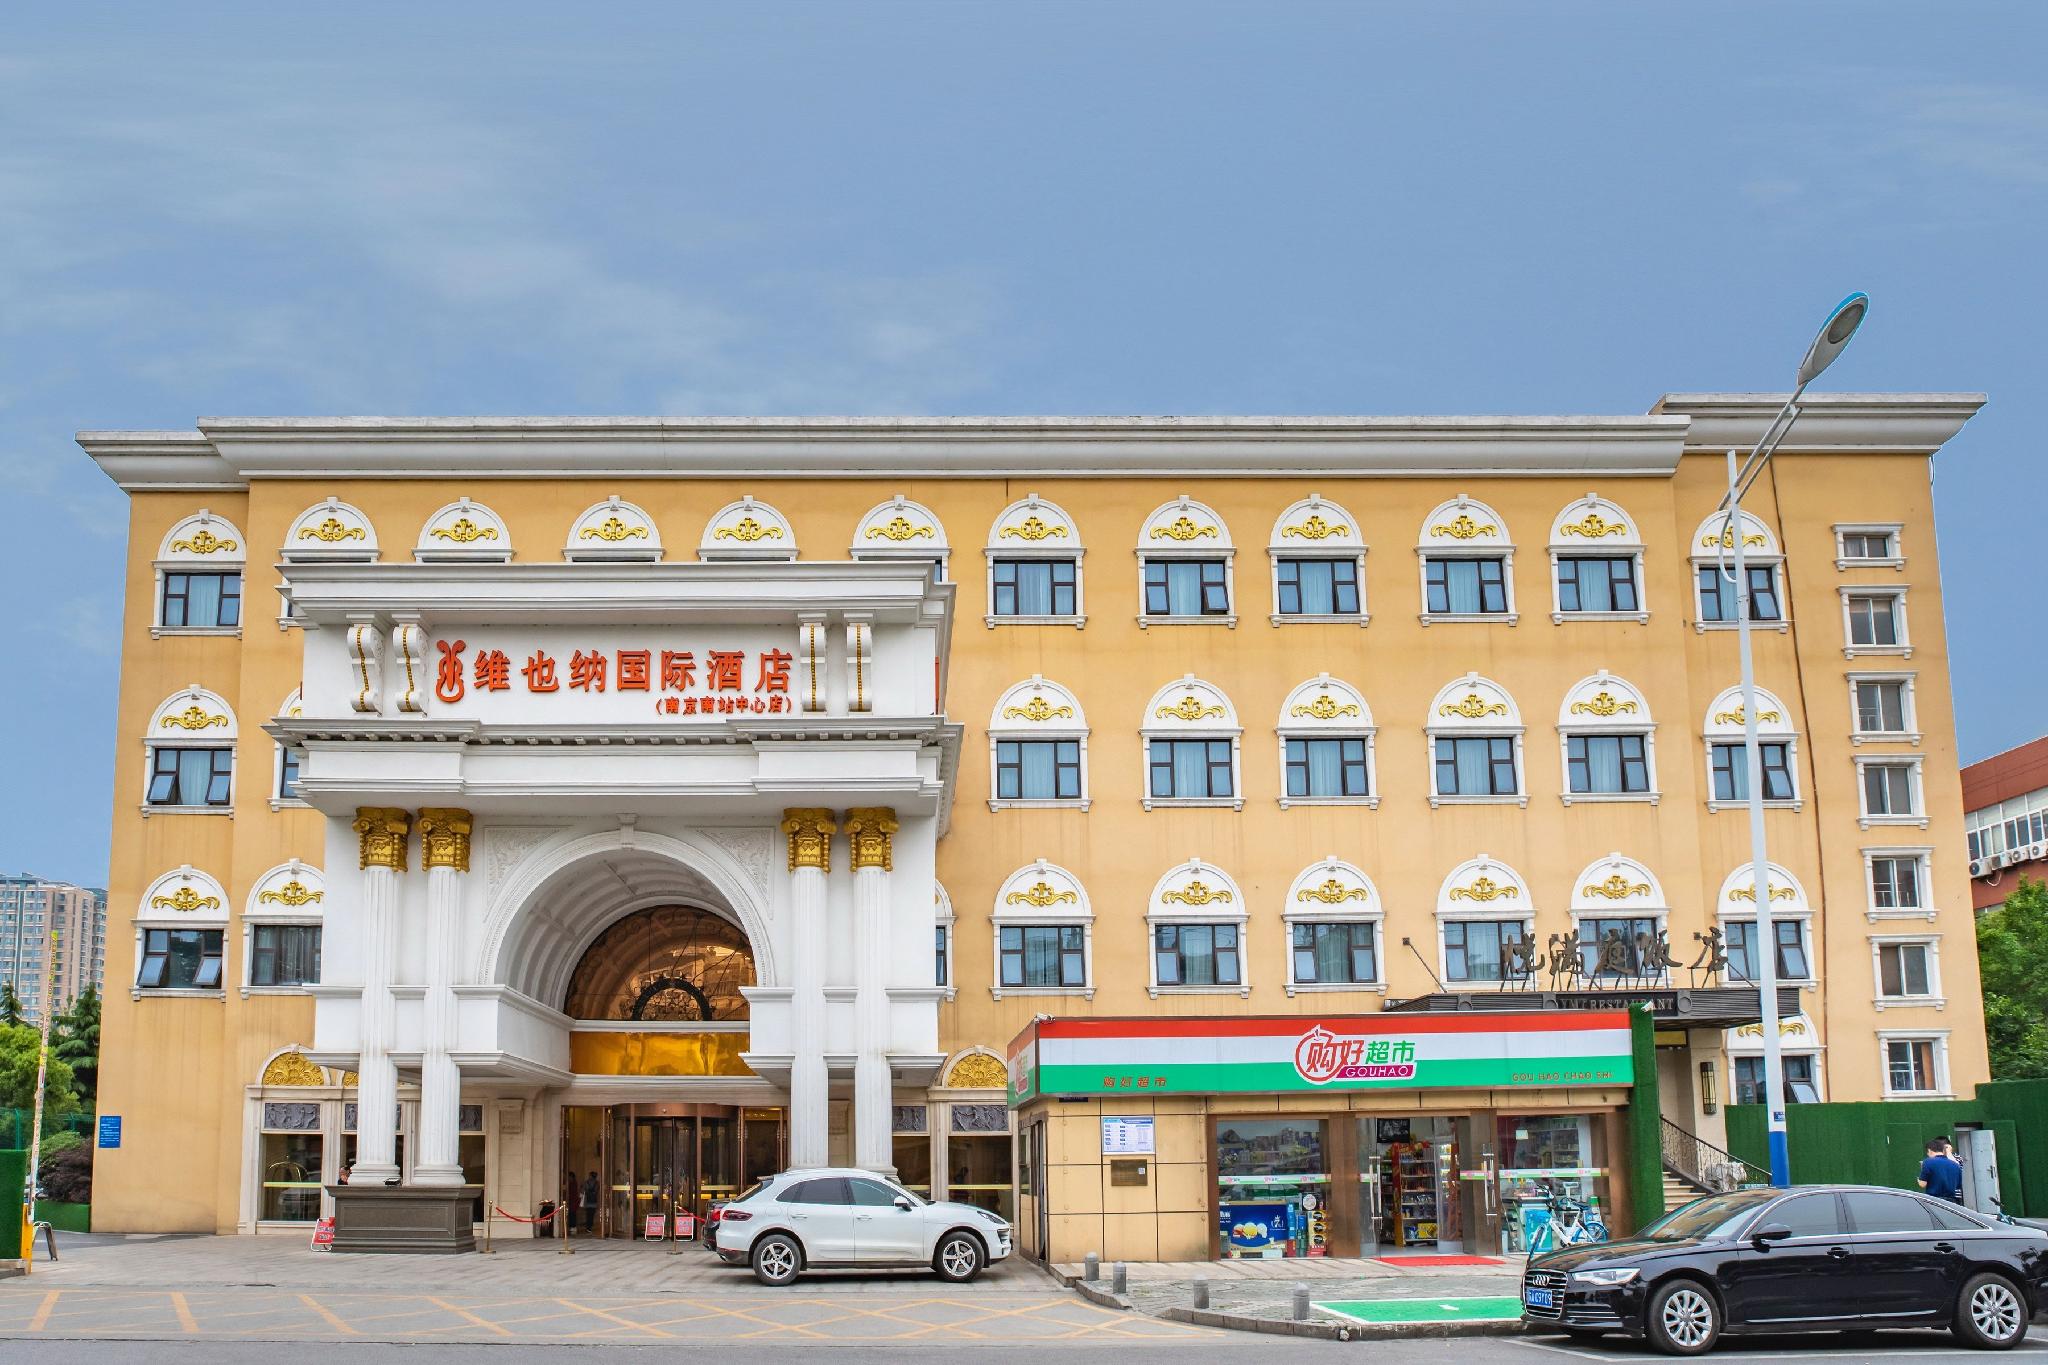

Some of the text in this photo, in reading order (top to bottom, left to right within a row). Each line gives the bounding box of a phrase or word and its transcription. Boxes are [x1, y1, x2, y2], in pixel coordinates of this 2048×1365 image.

[473, 648, 793, 693] 维也纳国际酒店
[1304, 1037, 1415, 1073] 购好超市
[1345, 1066, 1409, 1077] GOUHAO
[1538, 1072, 1559, 1081] HAO
